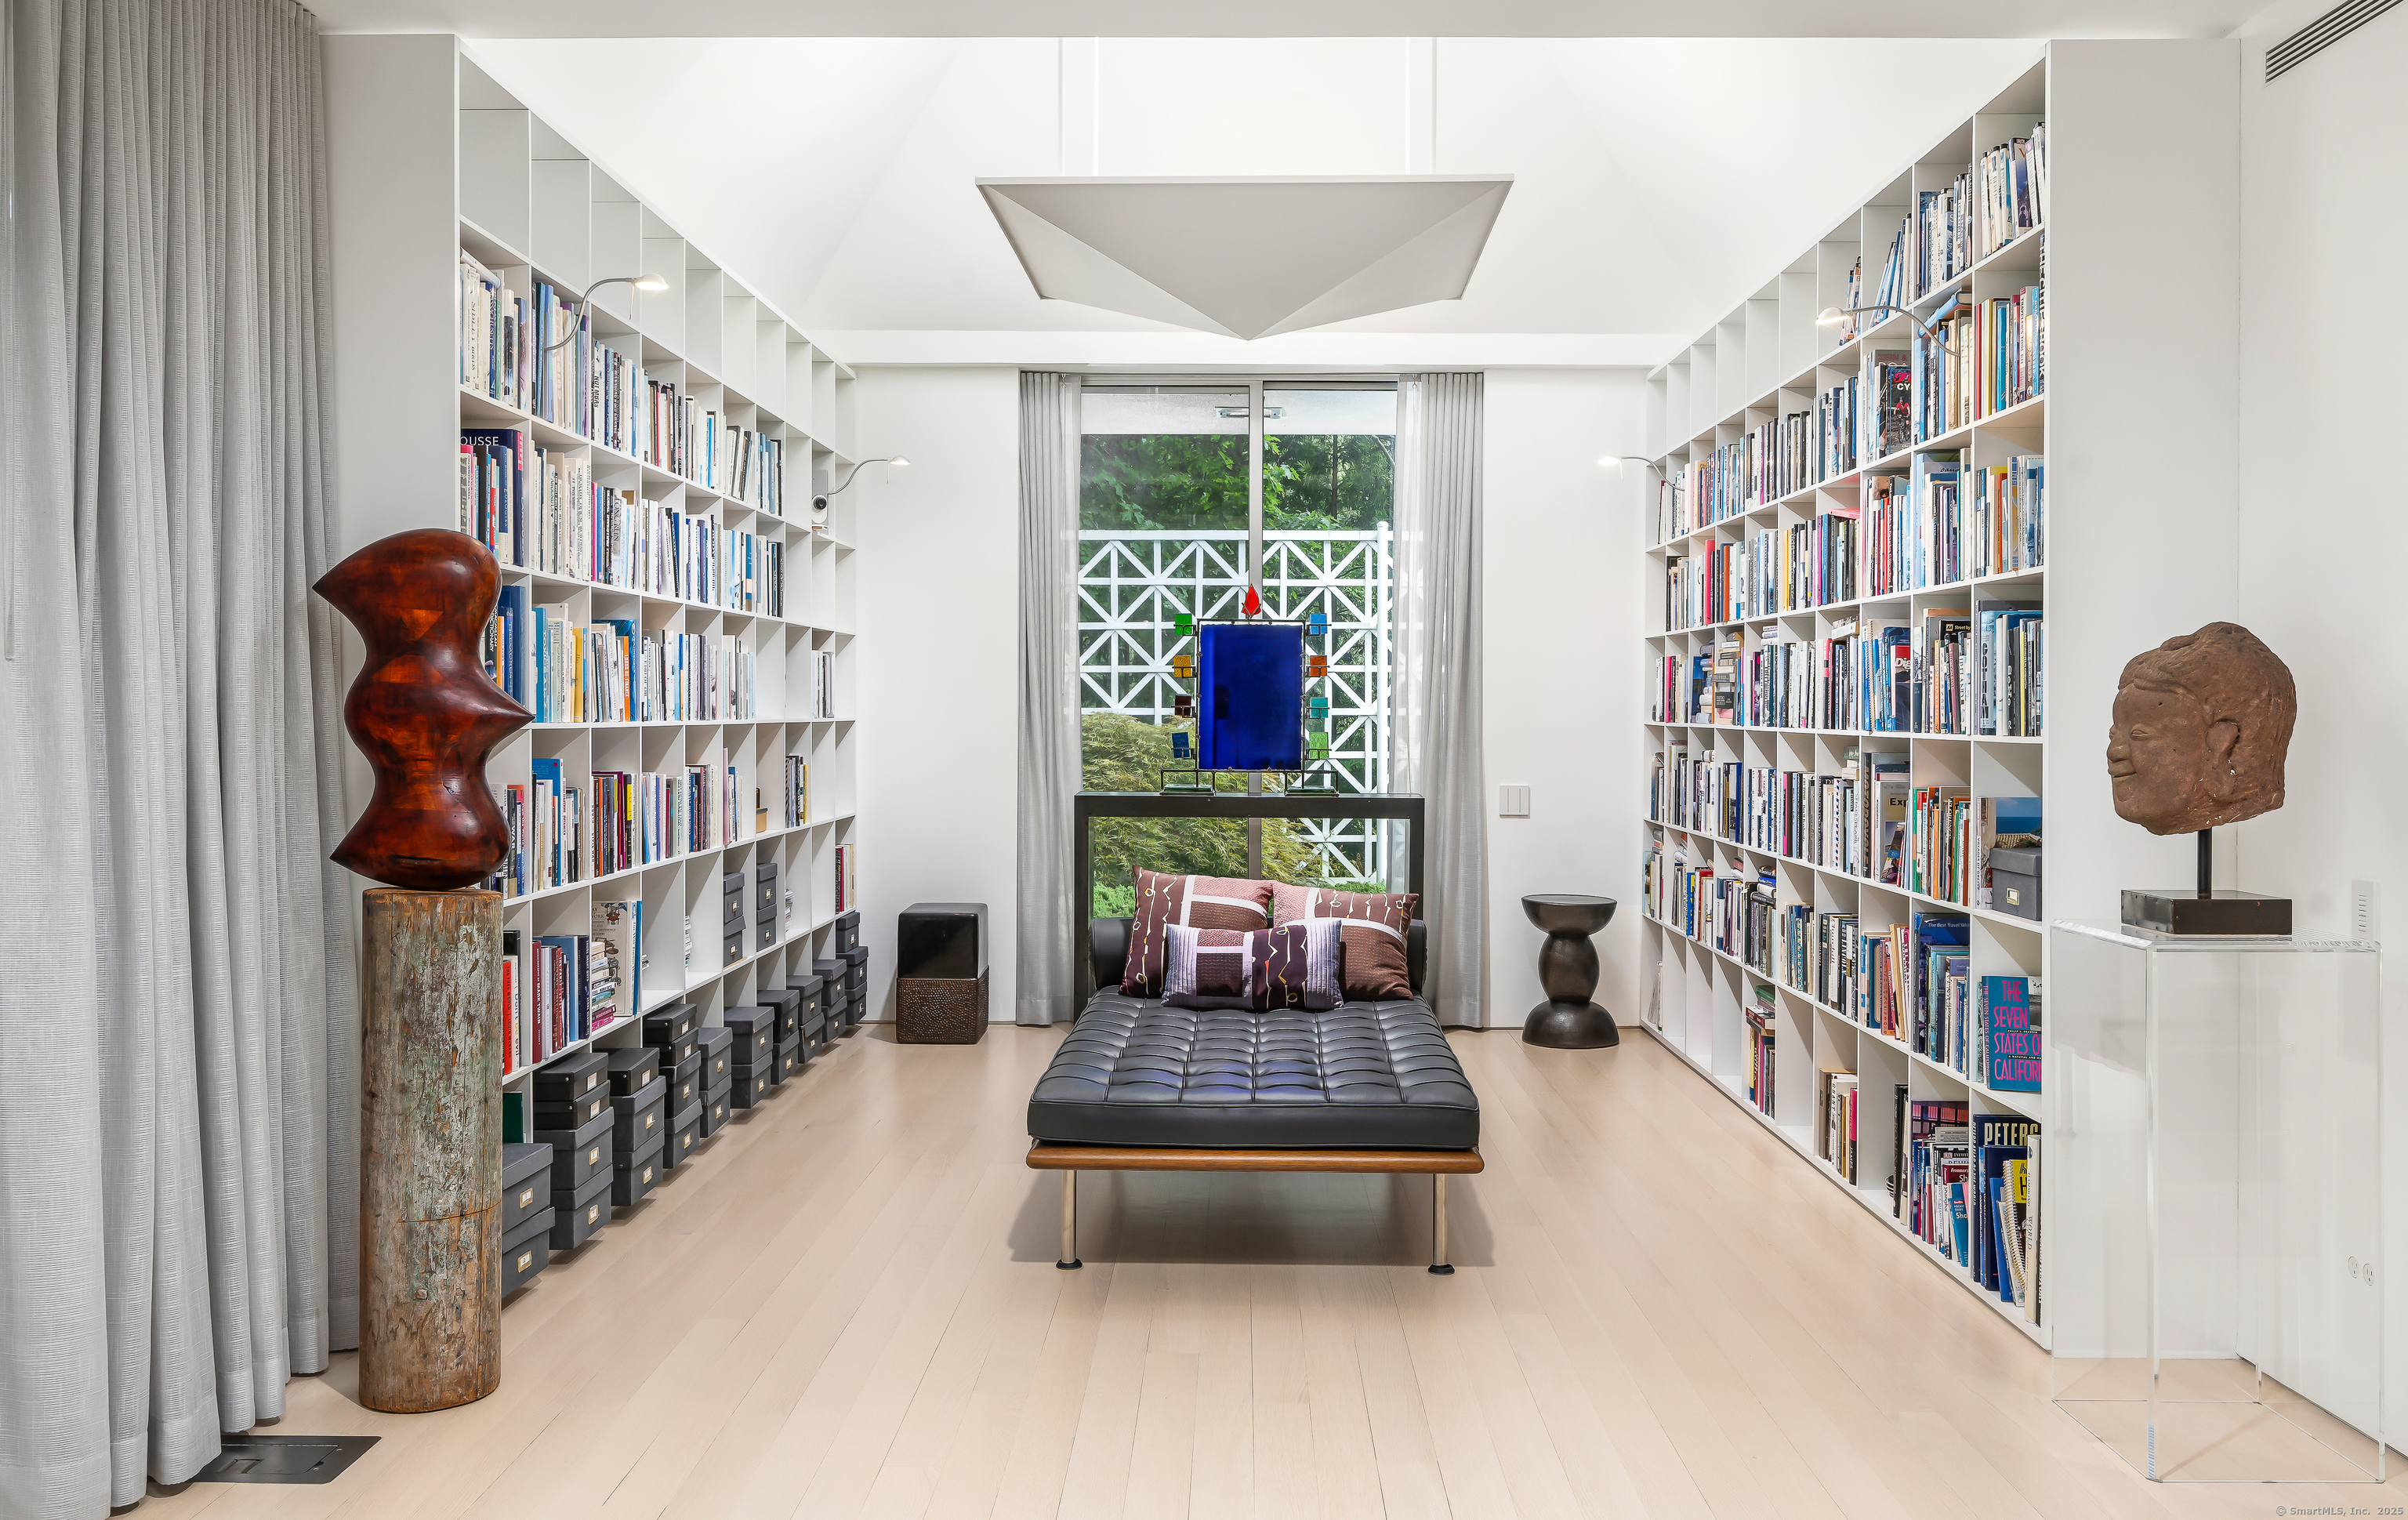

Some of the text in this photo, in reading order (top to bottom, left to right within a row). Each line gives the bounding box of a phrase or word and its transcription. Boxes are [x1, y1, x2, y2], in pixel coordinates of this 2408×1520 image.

[2002, 981, 2022, 1002] THE
[1993, 1006, 2028, 1028] SEVEN
[515, 1022, 519, 1035] be
[1994, 1032, 2028, 1054] STATES
